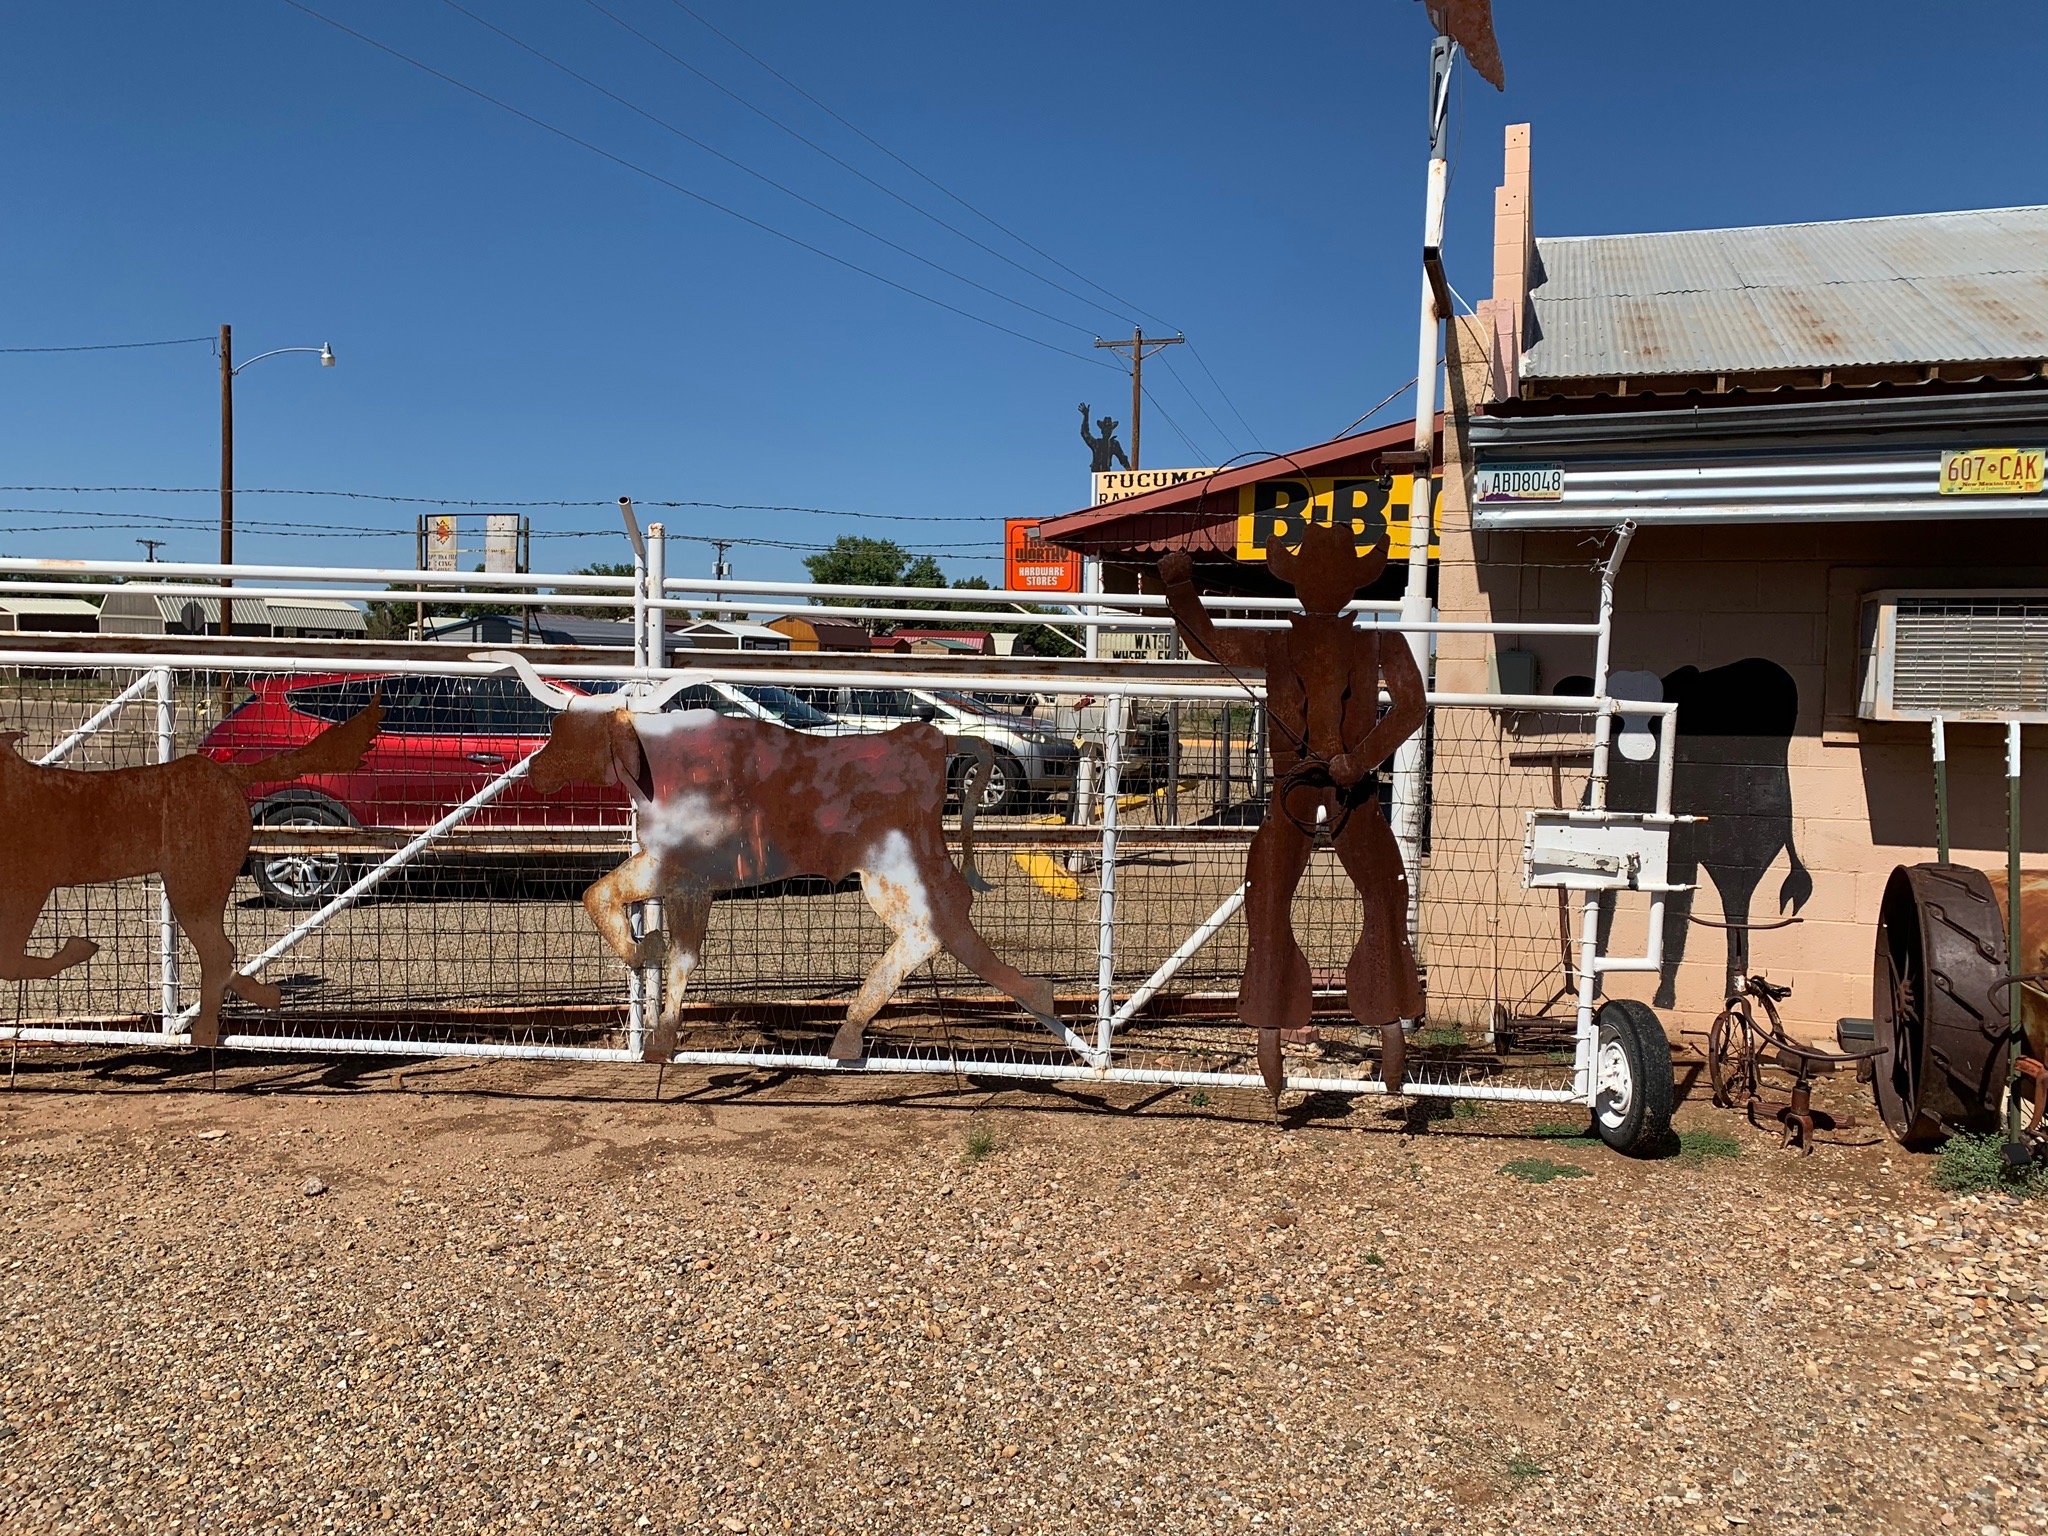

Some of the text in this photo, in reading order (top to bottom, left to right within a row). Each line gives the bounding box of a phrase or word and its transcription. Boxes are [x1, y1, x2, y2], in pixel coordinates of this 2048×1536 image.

[1948, 455, 2038, 481] 607 CAK
[1492, 471, 1561, 492] ABD8048
[1018, 566, 1065, 576] HARDWARE
[1026, 576, 1058, 586] STORES
